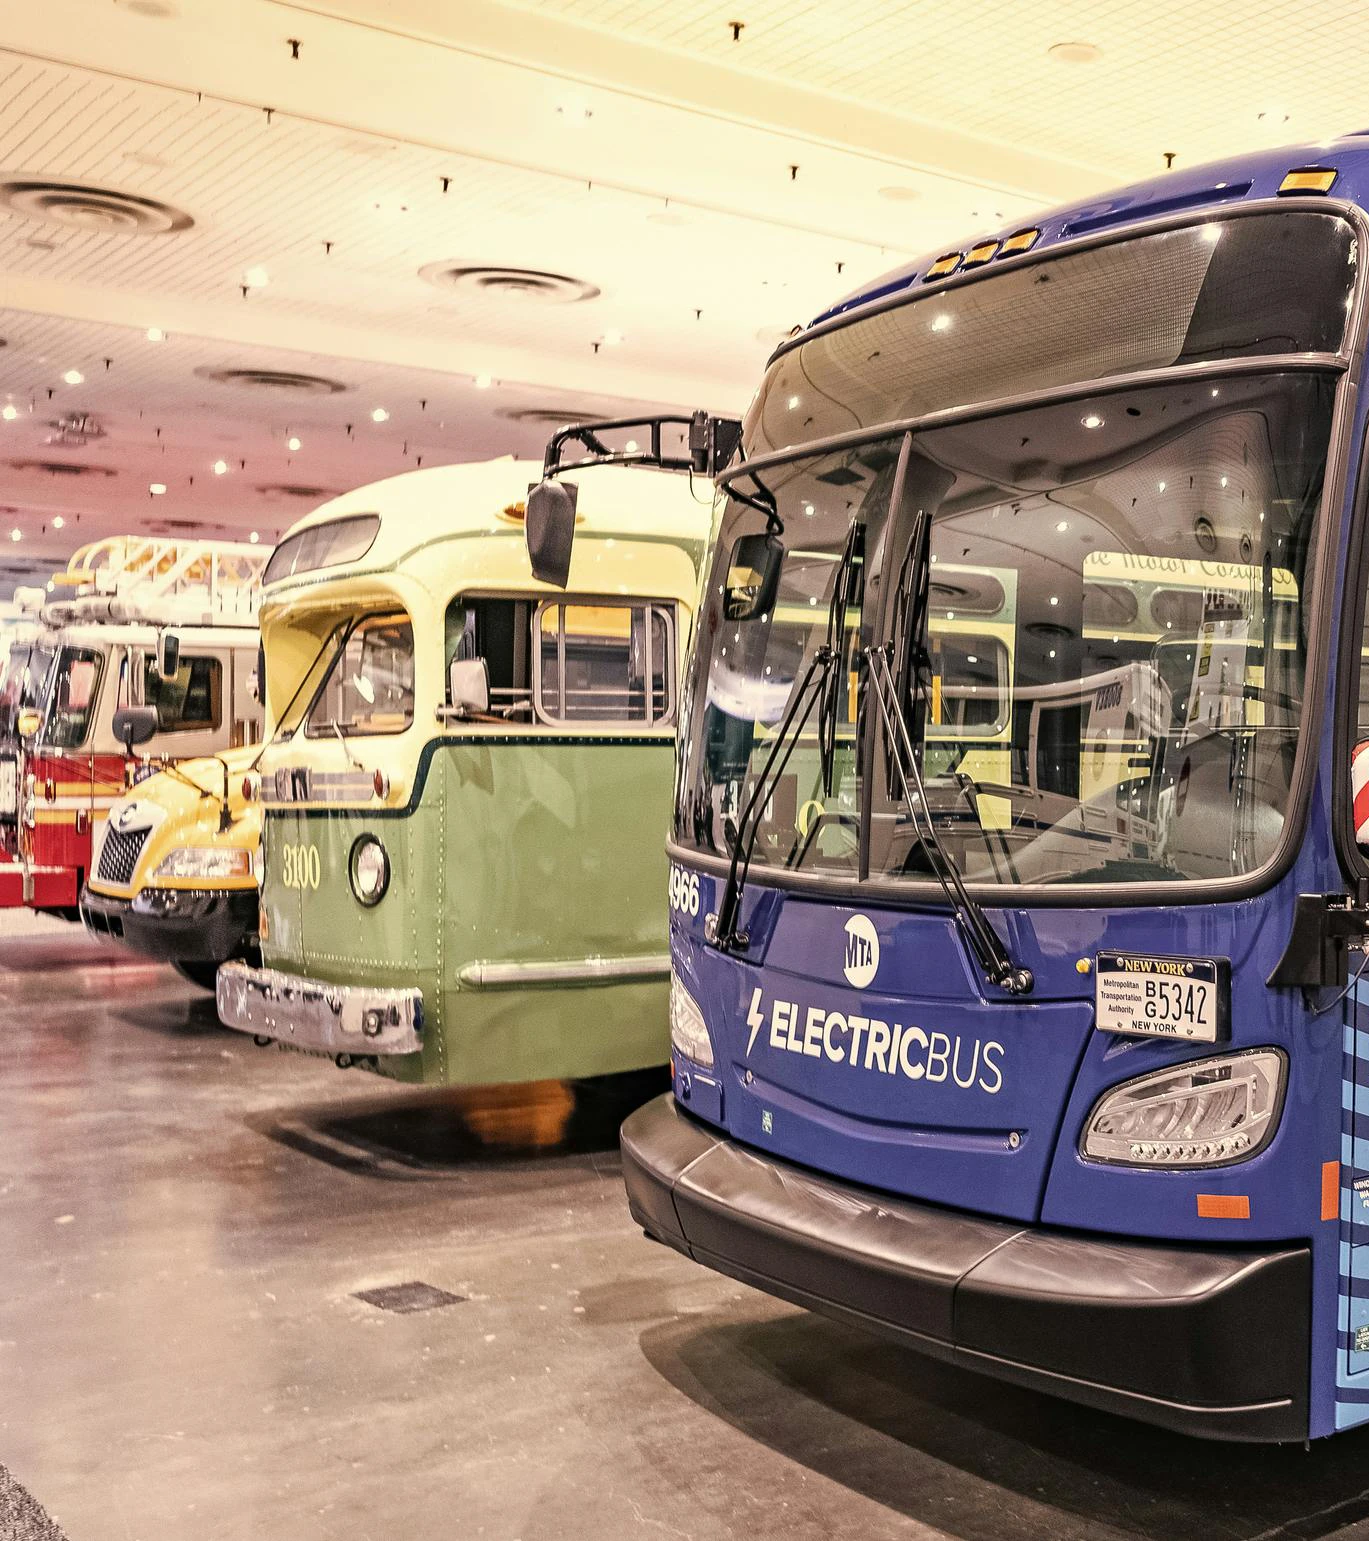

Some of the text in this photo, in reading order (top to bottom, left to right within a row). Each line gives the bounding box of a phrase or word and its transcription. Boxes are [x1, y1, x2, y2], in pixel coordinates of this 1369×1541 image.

[283, 843, 320, 890] 3100
[669, 865, 700, 917] 4966
[1124, 959, 1186, 977] NEW YORK
[1103, 979, 1140, 990] Metropolitan
[1101, 991, 1142, 1002] Transportation
[1108, 1004, 1135, 1015] Authority
[1132, 1020, 1177, 1033] NEW YORK
[769, 999, 1006, 1095] ELECTRICBUS
